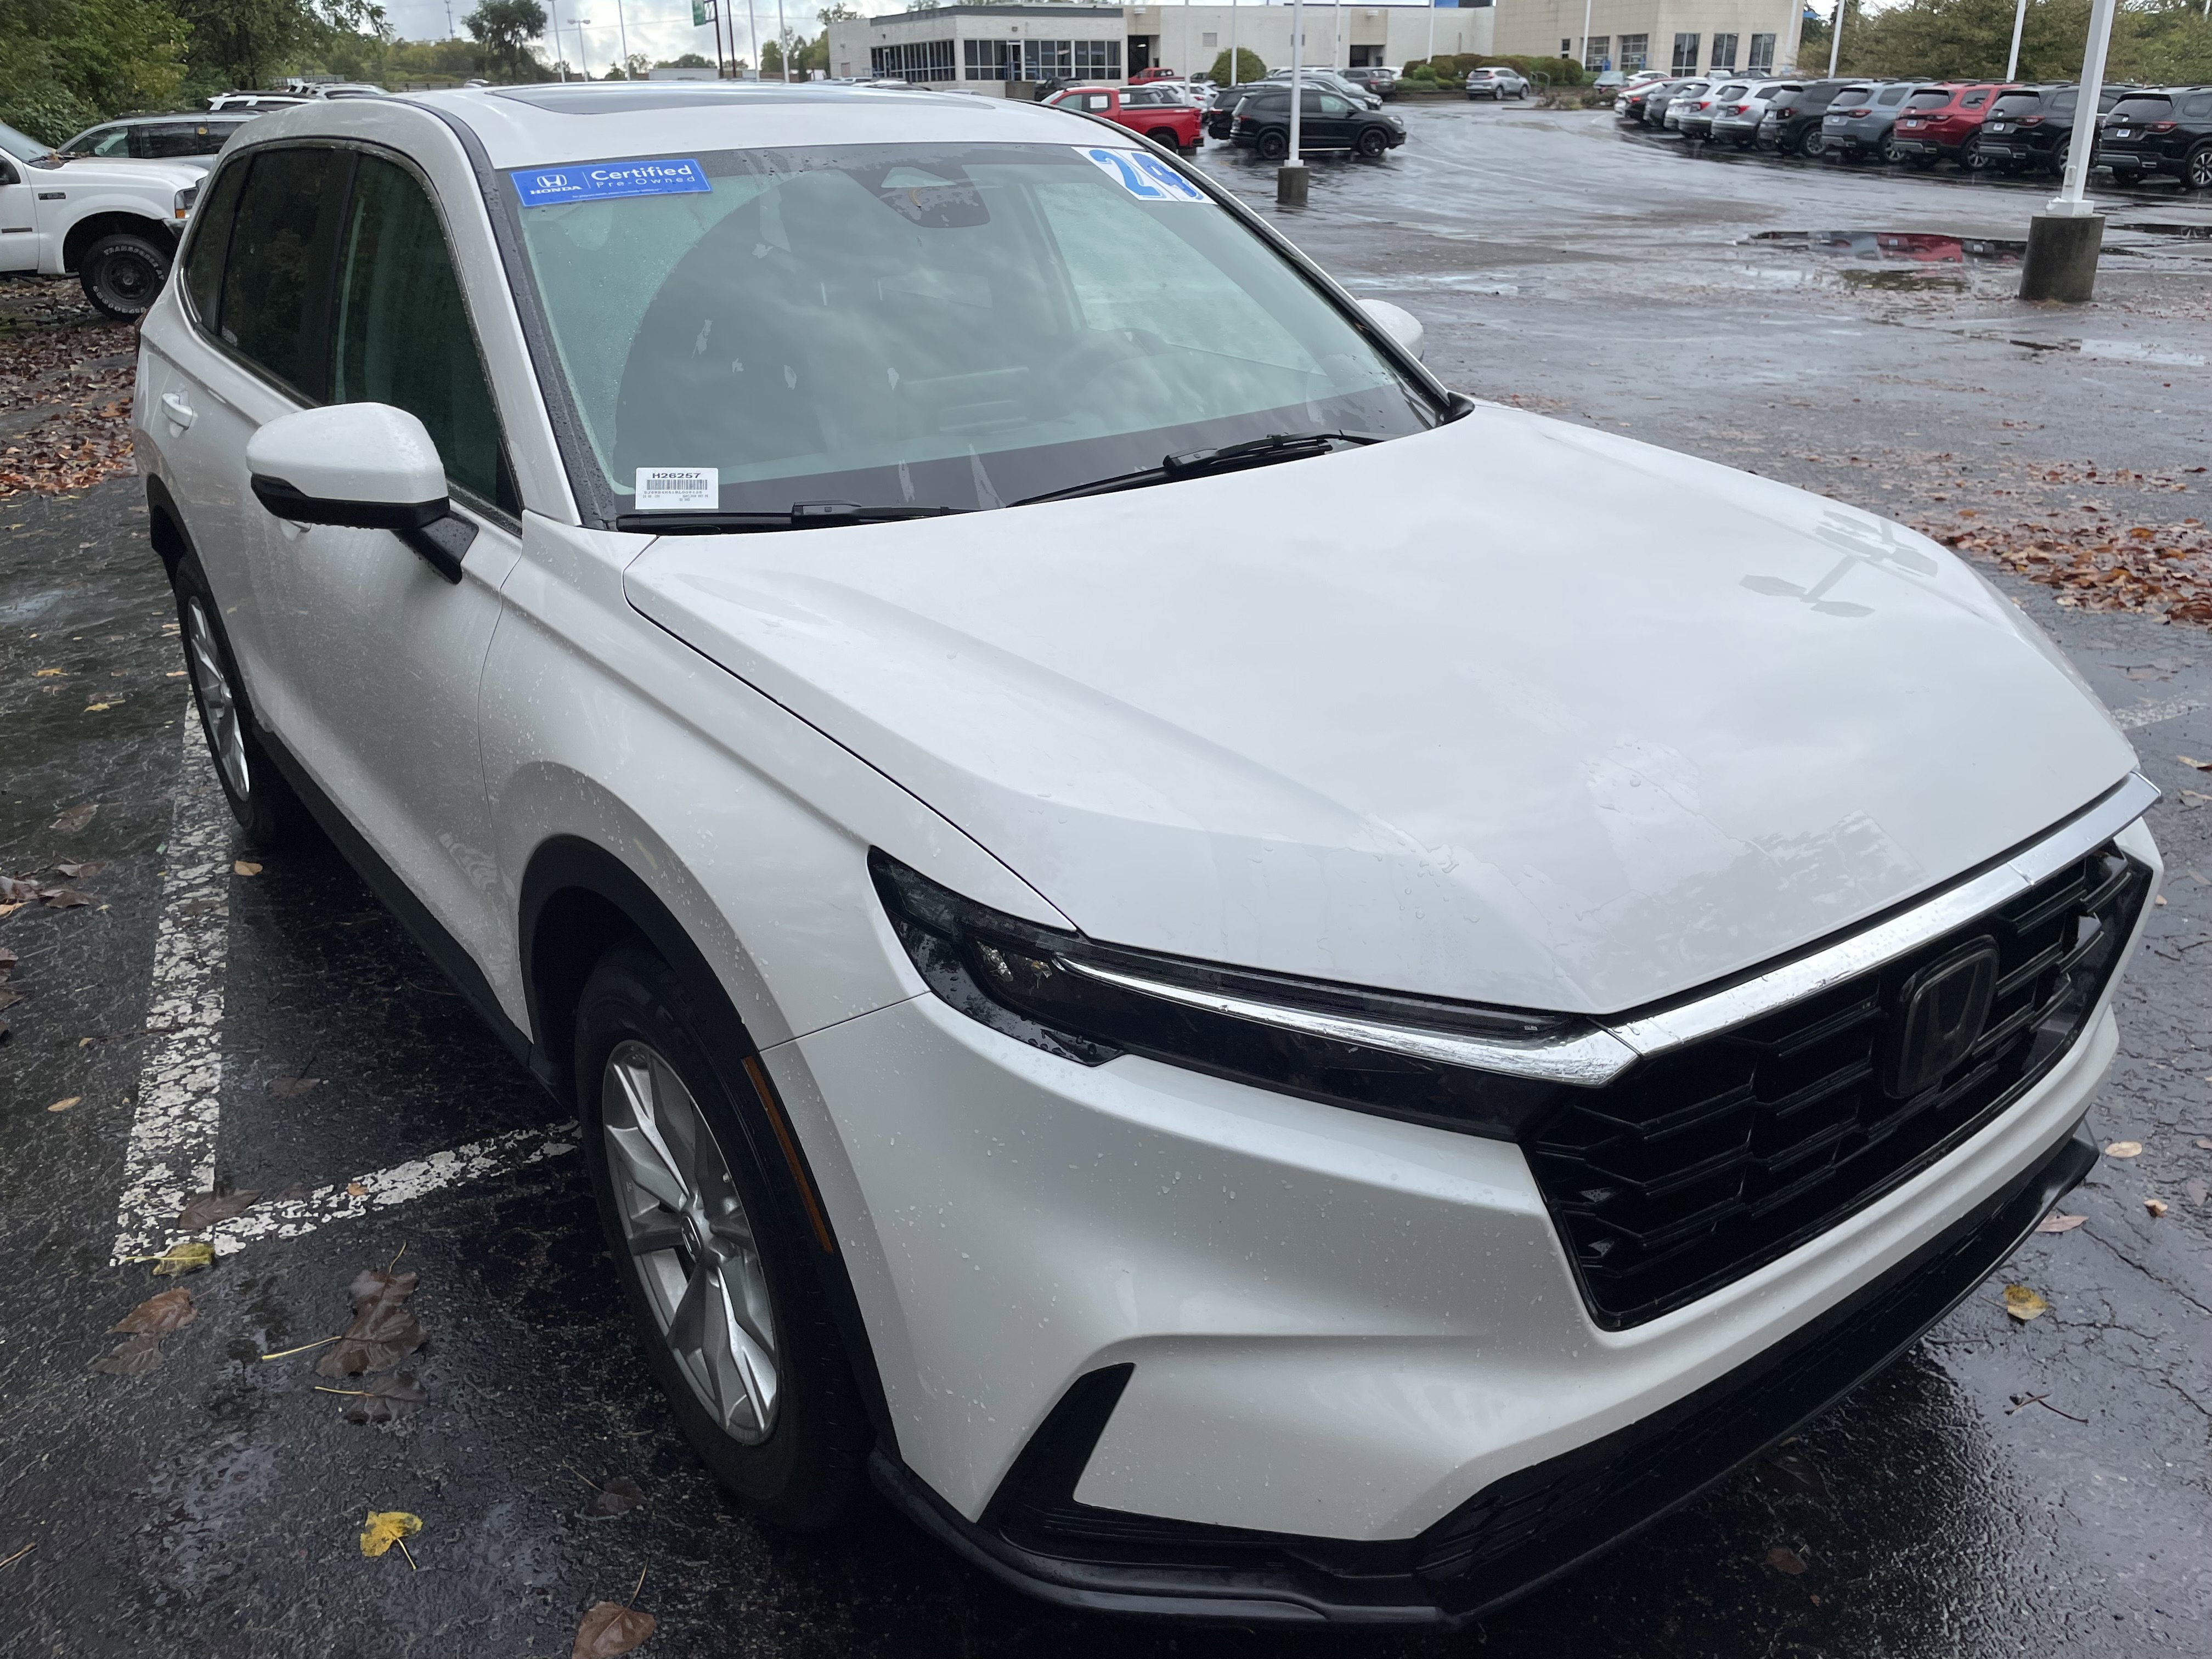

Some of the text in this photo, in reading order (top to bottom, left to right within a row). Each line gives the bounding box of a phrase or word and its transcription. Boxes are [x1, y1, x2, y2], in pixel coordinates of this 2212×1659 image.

[591, 165, 692, 181] Certified
[596, 176, 695, 188] Pre-Owned
[529, 185, 583, 195] HONDA
